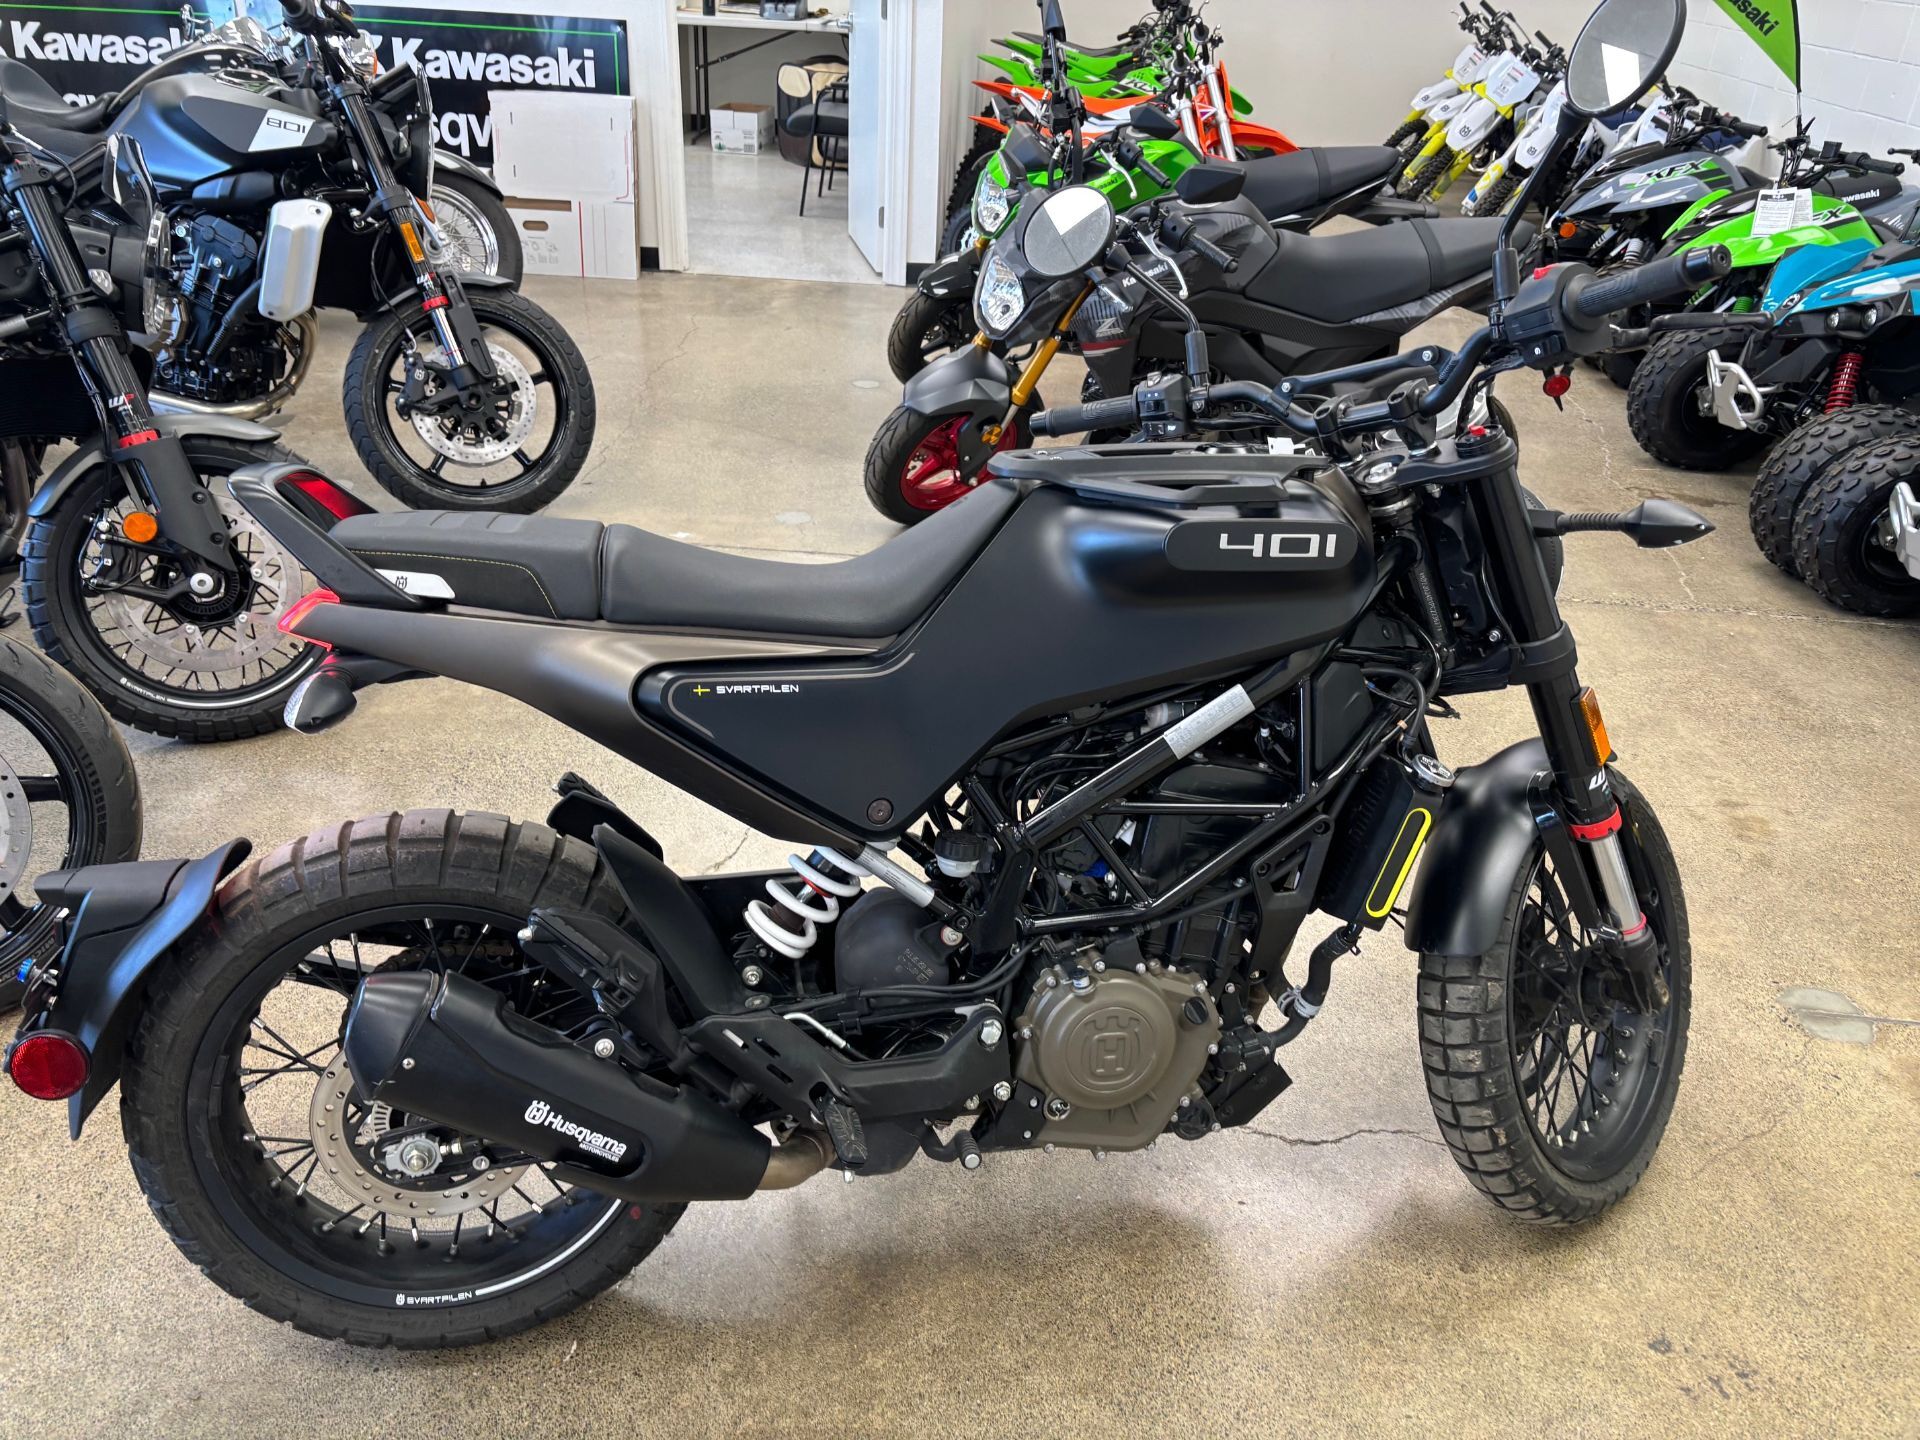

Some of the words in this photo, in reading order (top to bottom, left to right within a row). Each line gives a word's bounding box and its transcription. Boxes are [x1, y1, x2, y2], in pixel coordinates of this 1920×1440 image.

[391, 37, 596, 88] Kawasaki
[266, 117, 306, 134] 801
[1219, 533, 1337, 558] 401
[716, 684, 799, 695] SVARTPILEN
[543, 1111, 627, 1156] Husqvarna
[579, 1142, 620, 1163] MOTORCYCLES
[406, 1290, 473, 1305] SVARTPILEN
